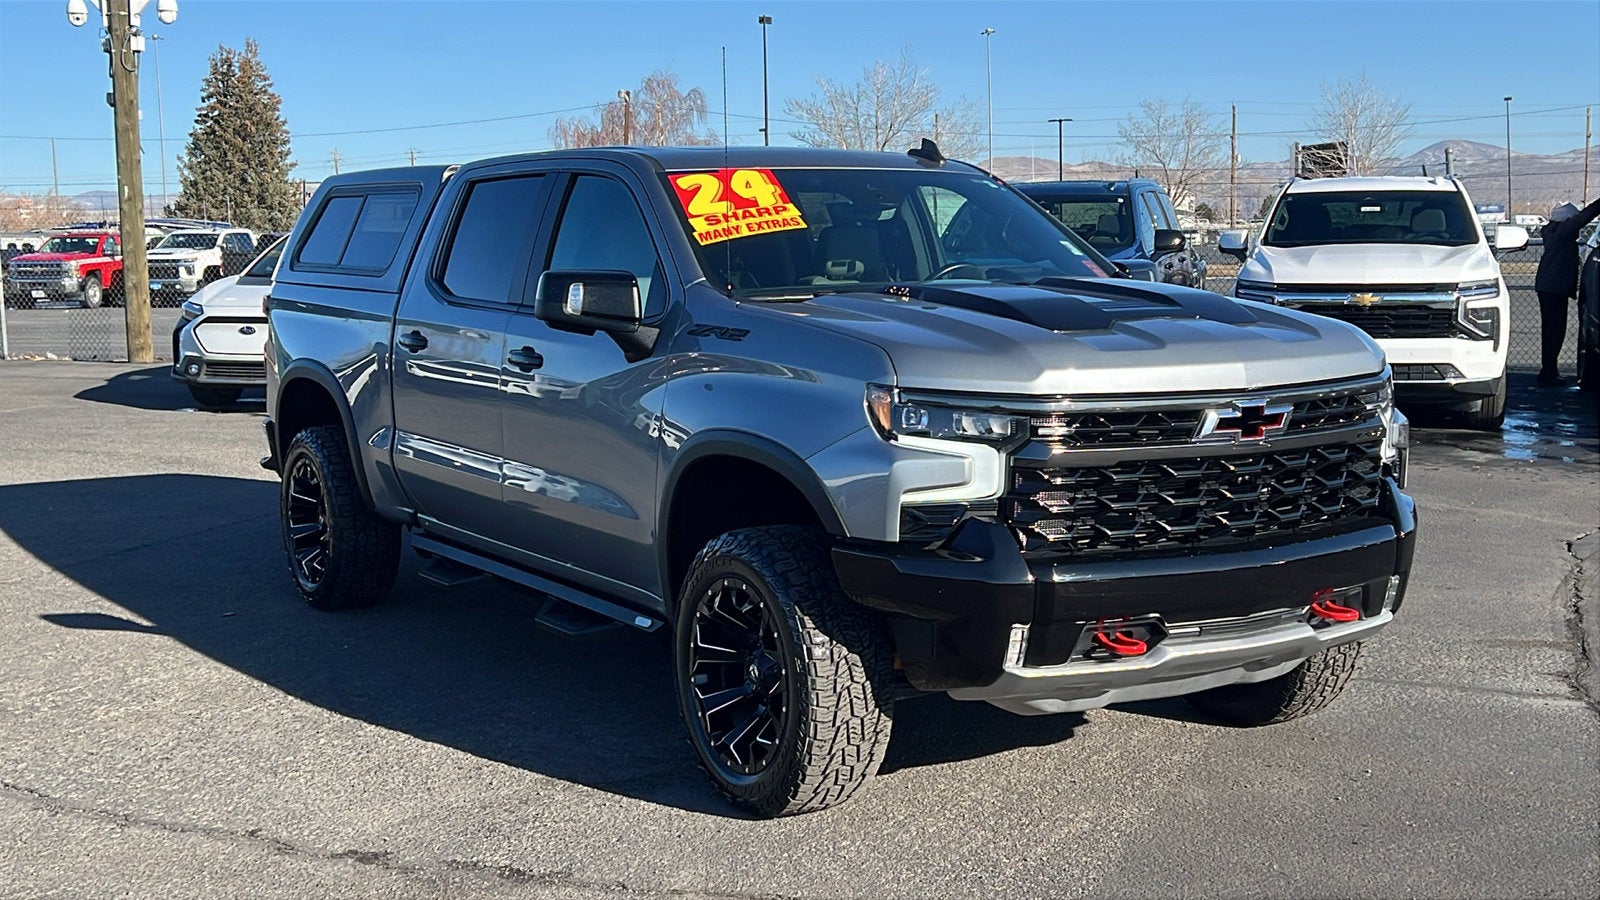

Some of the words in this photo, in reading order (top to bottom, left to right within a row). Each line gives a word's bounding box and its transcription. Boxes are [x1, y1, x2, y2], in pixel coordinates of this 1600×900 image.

[676, 169, 782, 216] 24
[704, 205, 789, 226] SHARP
[698, 224, 742, 243] MANY
[749, 217, 801, 233] EXTRAS
